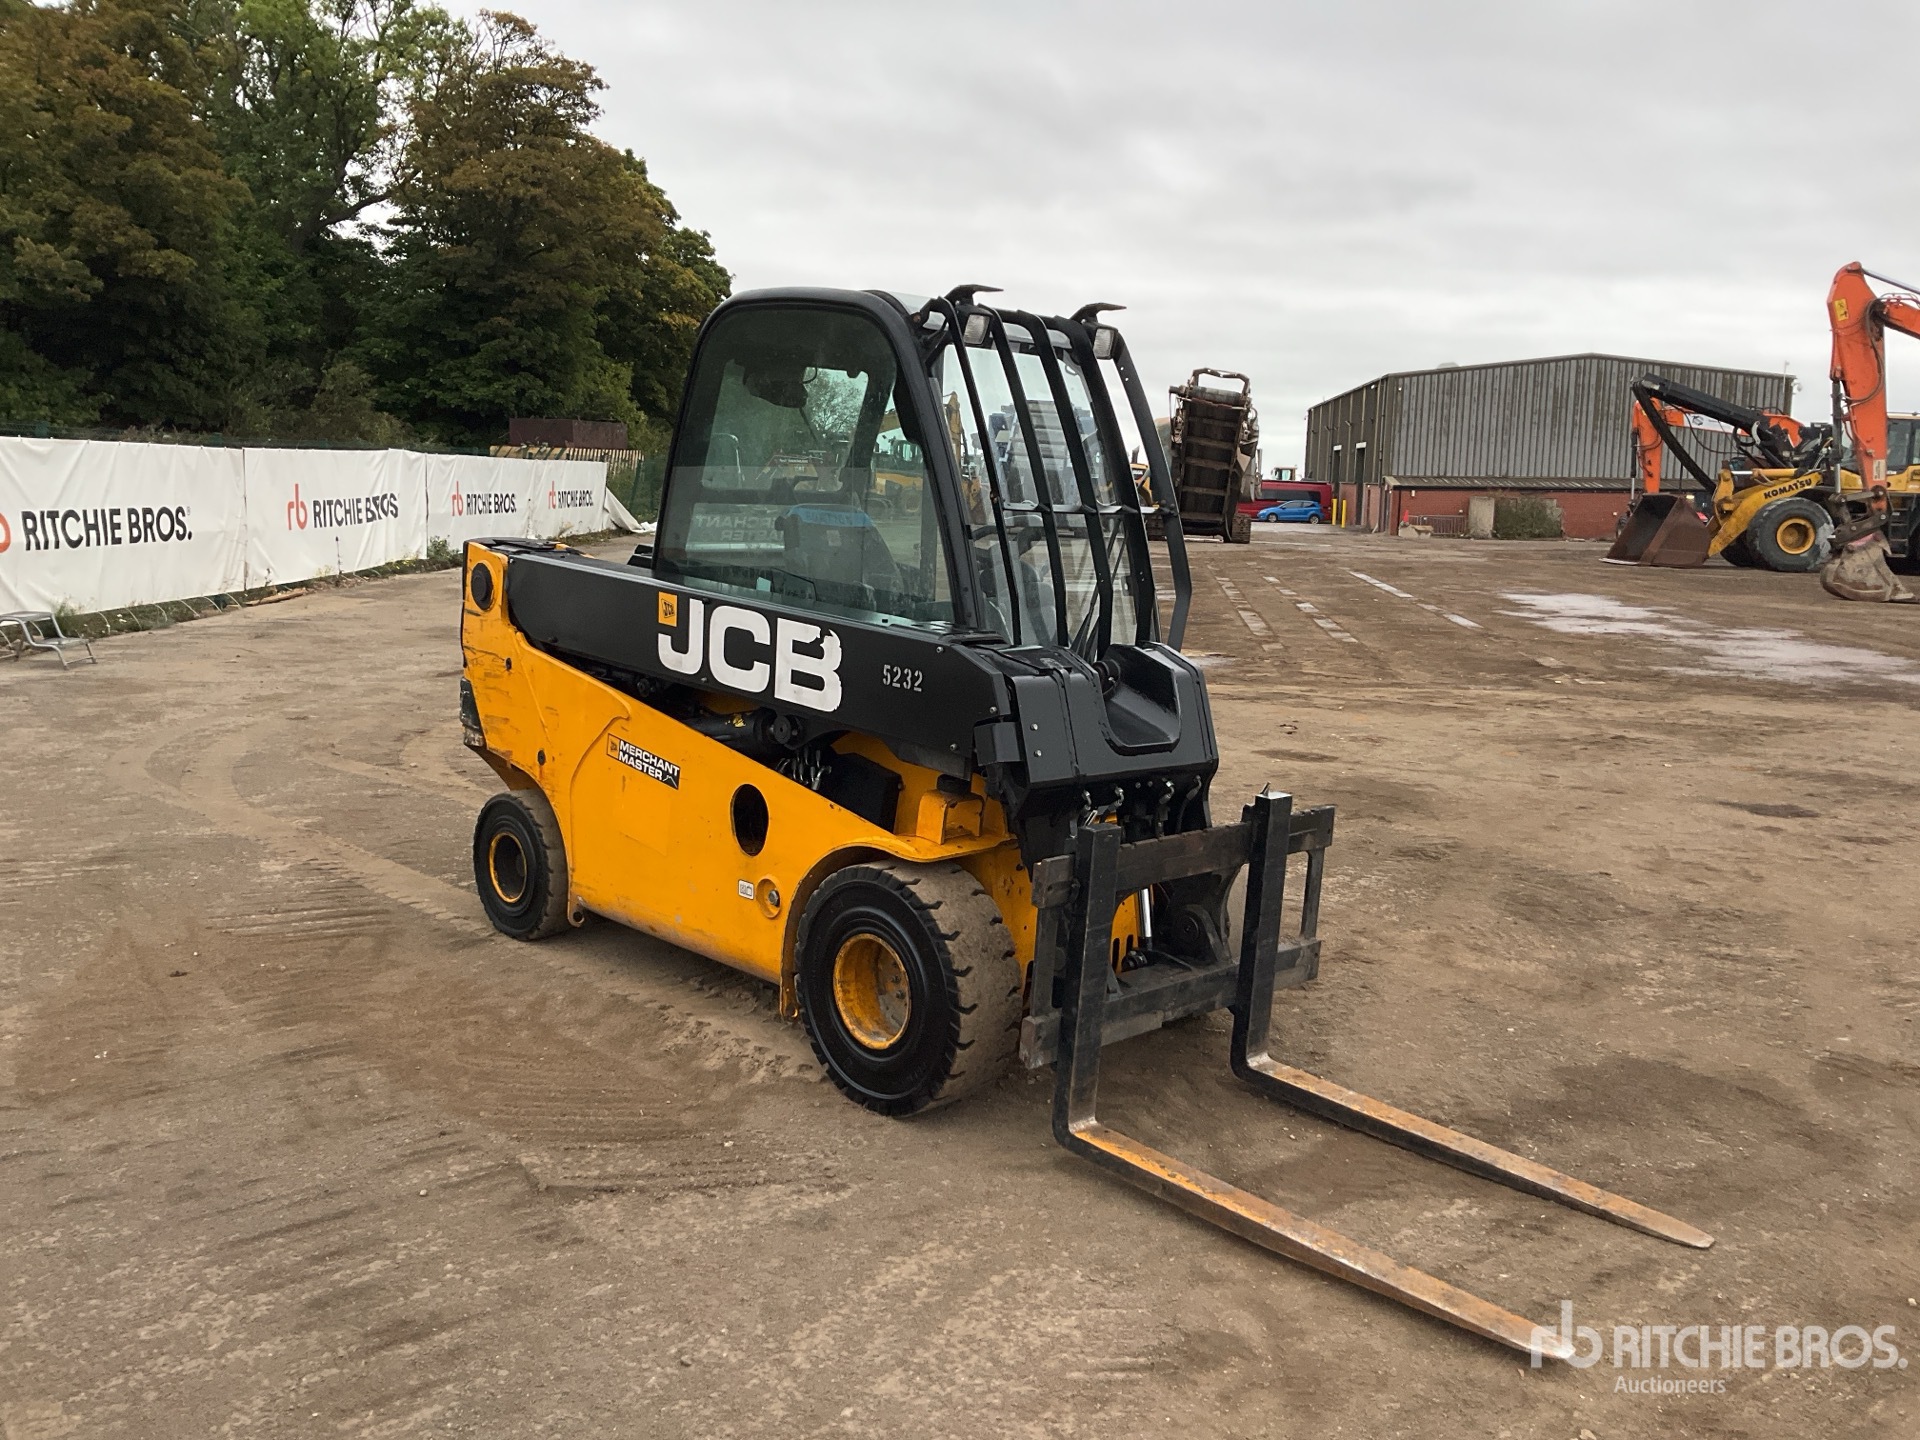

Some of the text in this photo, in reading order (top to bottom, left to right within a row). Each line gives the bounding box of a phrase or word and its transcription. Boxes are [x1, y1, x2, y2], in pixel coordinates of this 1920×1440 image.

[1763, 478, 1812, 500] KOMATSU
[21, 507, 122, 551] RITCHIE
[128, 506, 193, 544] BROS.
[312, 498, 364, 529] RITCHIE
[657, 597, 842, 712] JCB
[882, 664, 924, 692] 5232
[619, 750, 663, 781] MASTER
[620, 739, 680, 776] MERCHANT
